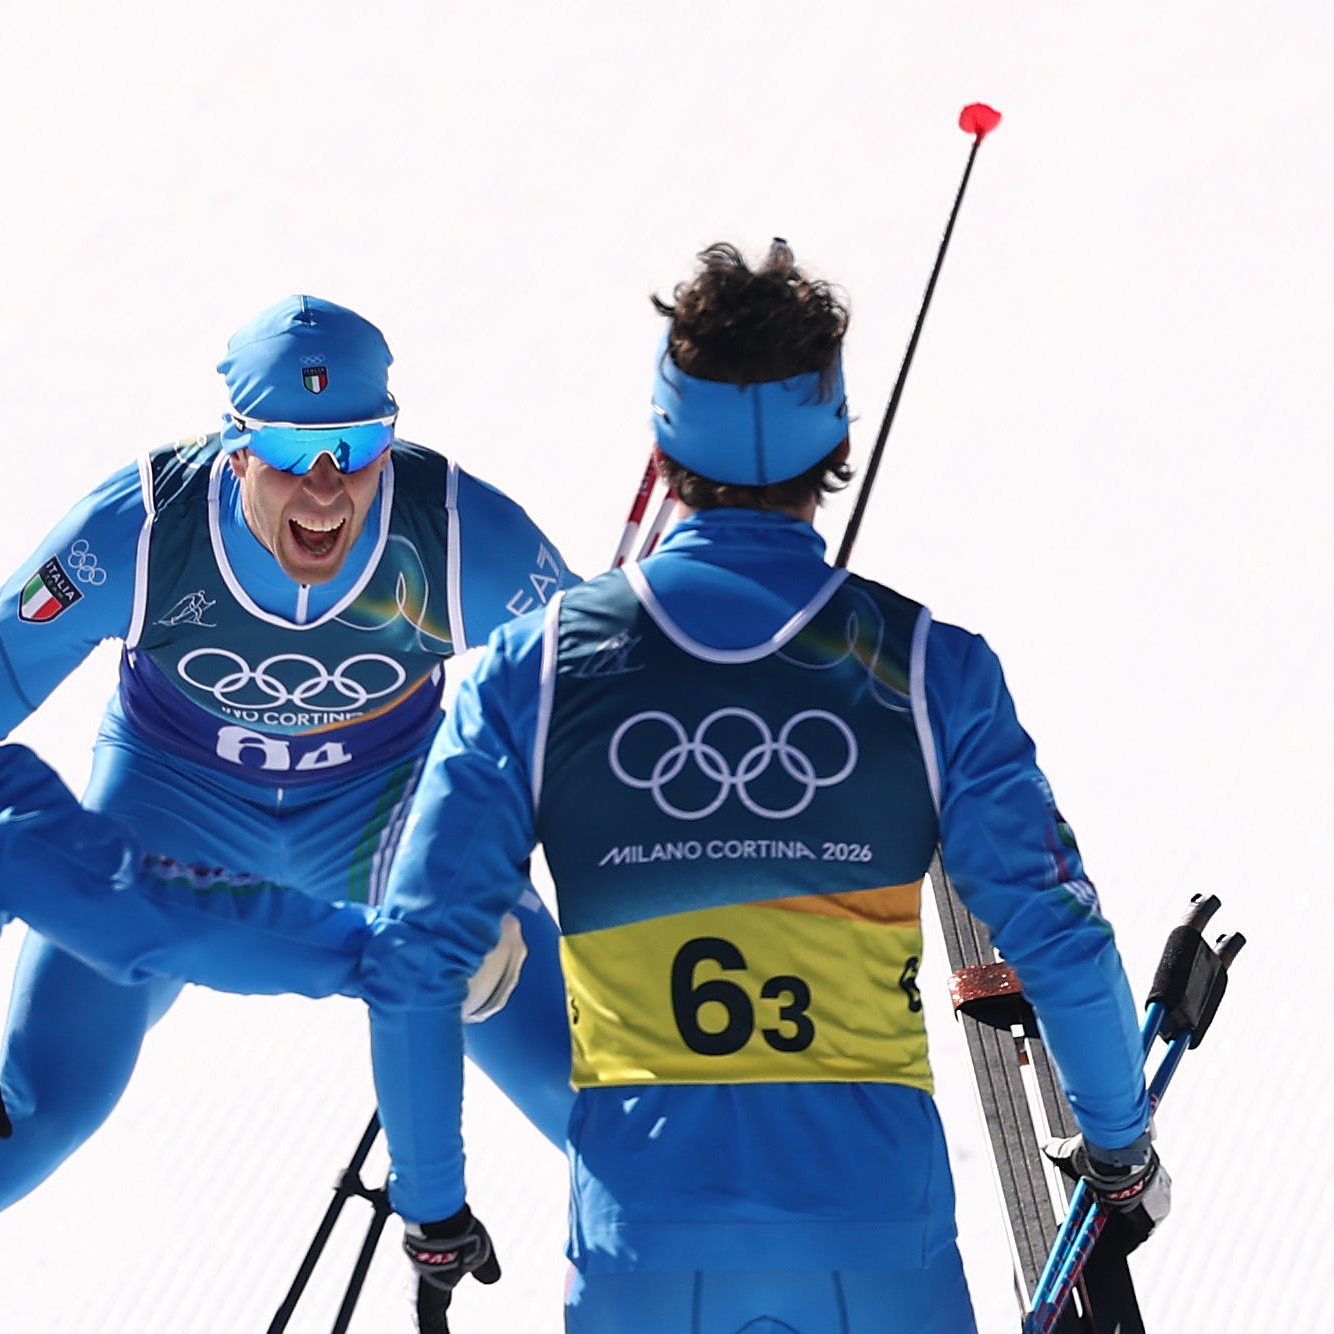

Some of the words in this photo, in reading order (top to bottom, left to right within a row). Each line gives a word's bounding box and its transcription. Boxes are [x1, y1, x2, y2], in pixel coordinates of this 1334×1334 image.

[45, 561, 76, 601] ITALIA
[598, 840, 702, 867] MILANO
[706, 840, 817, 860] CORTINA
[822, 843, 873, 862] 2026
